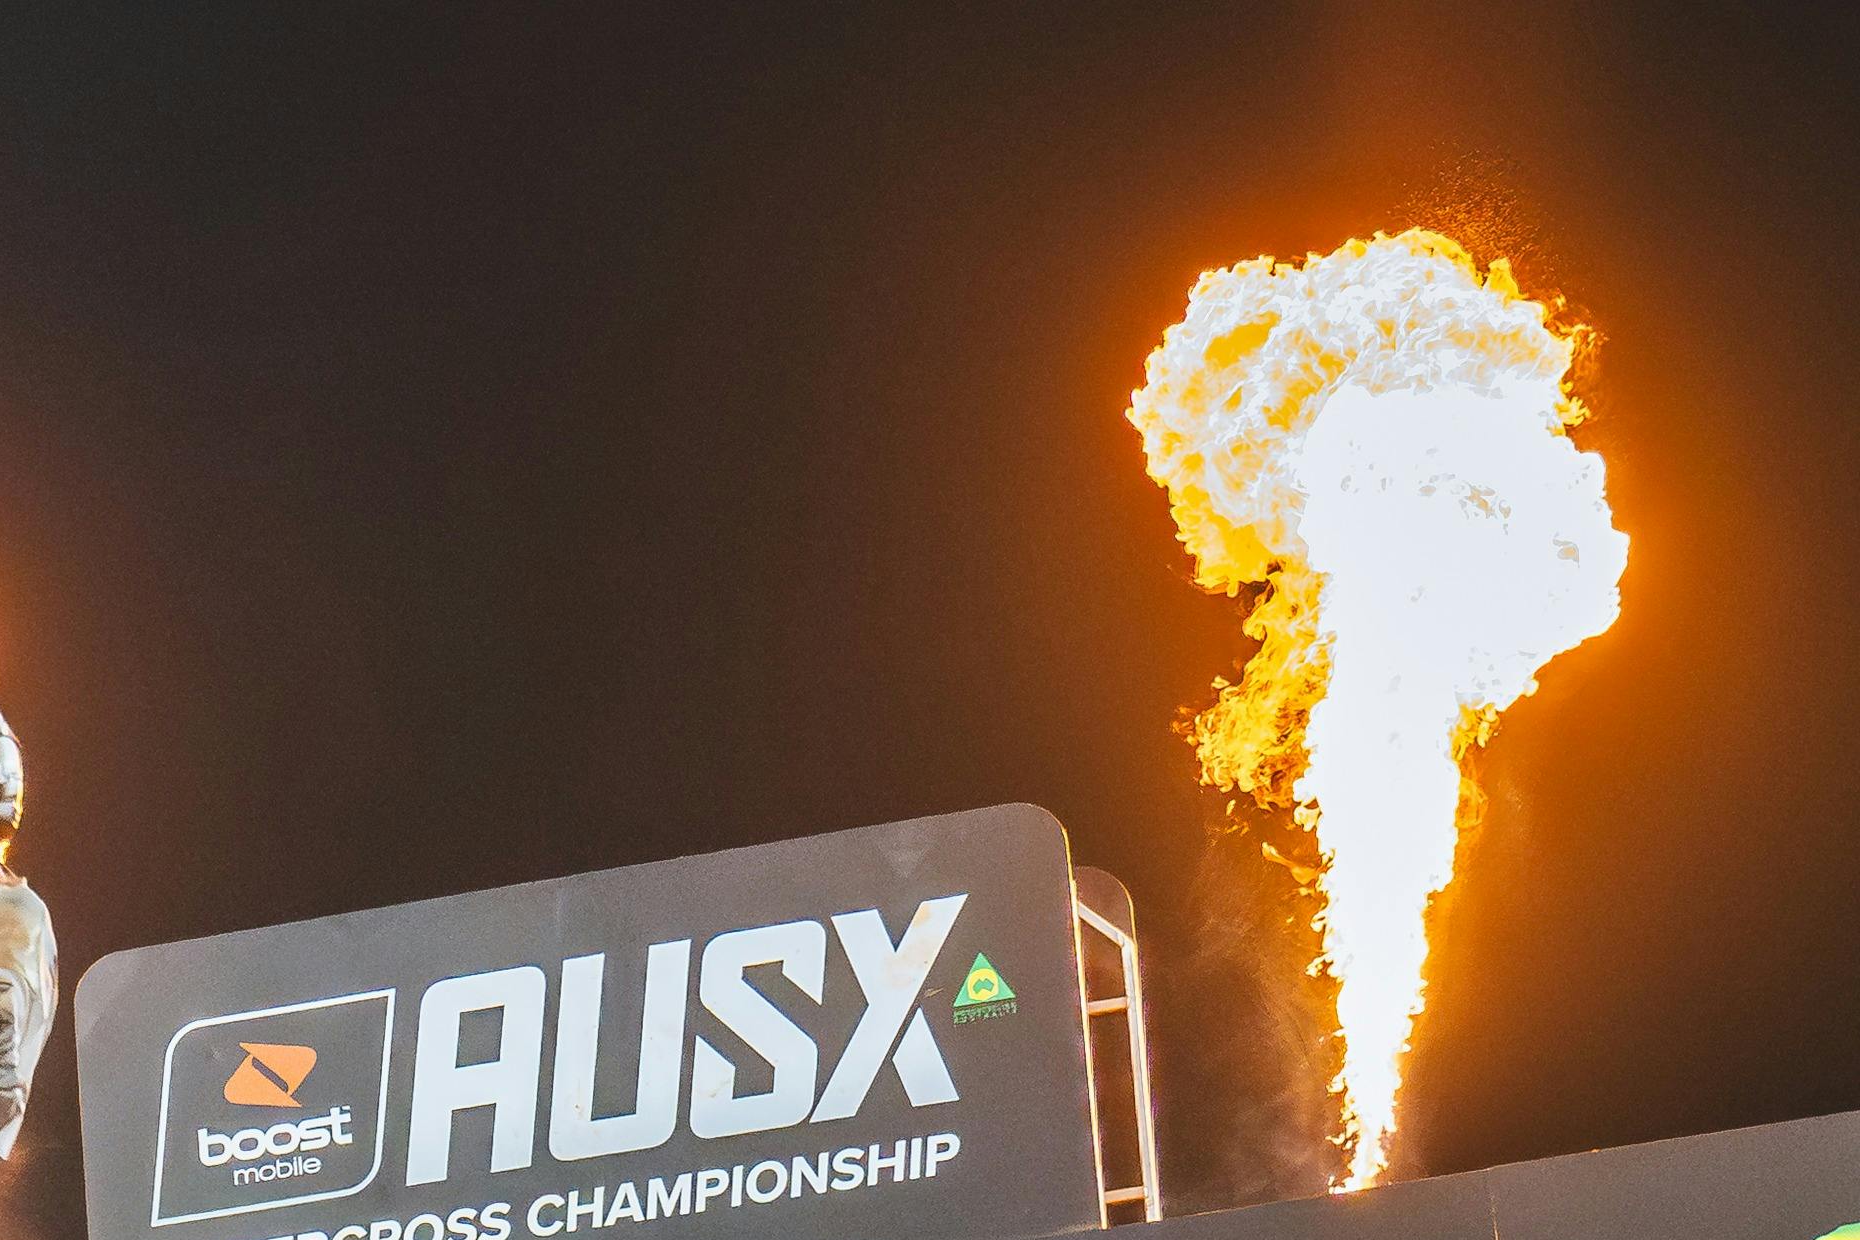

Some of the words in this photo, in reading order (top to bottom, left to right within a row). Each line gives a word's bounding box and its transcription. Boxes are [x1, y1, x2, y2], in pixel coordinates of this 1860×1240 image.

[404, 892, 970, 1188] AUSX
[197, 1104, 353, 1167] boost
[231, 1154, 323, 1188] mobile
[526, 1132, 962, 1238] CHAMPIONSHIP
